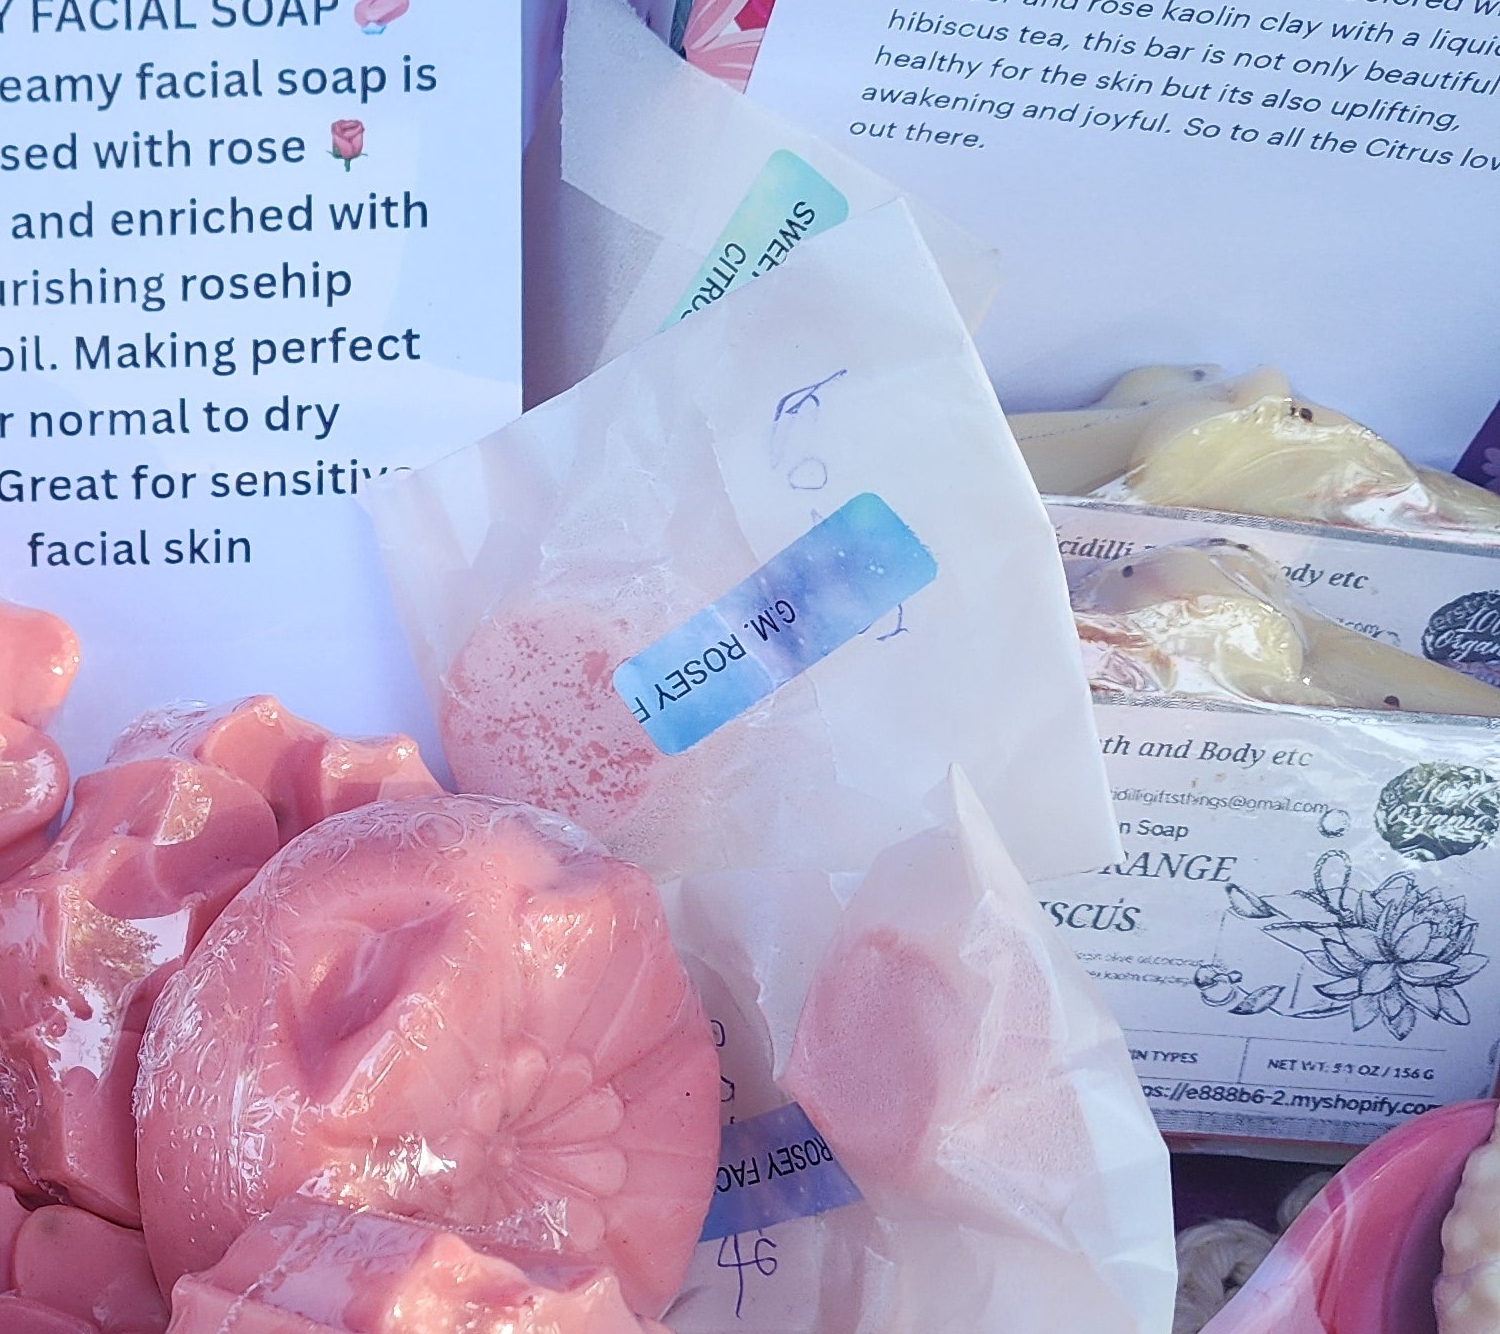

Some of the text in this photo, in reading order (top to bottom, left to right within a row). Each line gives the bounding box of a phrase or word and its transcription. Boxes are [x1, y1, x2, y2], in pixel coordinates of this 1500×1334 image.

[1259, 11, 1324, 40] clay
[1331, 20, 1394, 45] with
[1401, 31, 1421, 47] a
[887, 8, 1500, 95] hibiscus tea, this bar is not only beautiful
[135, 58, 263, 101] facial
[277, 65, 387, 105] soap
[402, 54, 437, 93] is
[874, 44, 1460, 132] healthy for the skin but its also uplifting,
[849, 121, 985, 149] out there.
[860, 86, 1016, 120] awakening
[1021, 102, 1081, 123] and
[1078, 105, 1172, 134] joyful.
[1183, 117, 1222, 139] So
[1229, 123, 1260, 143] to
[1266, 126, 1306, 148] all
[1309, 131, 1358, 154] the
[1365, 137, 1454, 165] Citrus
[92, 128, 191, 170] with
[208, 136, 306, 167] rose
[11, 200, 94, 240] and
[110, 193, 313, 237] enriched
[328, 190, 428, 231] with
[751, 200, 816, 278] SWEE
[181, 260, 352, 308] rosehip
[74, 331, 237, 377] Making
[251, 326, 421, 376] perfect
[29, 397, 191, 438] normal
[202, 401, 249, 434] to
[264, 394, 341, 441] dry
[130, 464, 197, 501] for
[210, 459, 411, 498] sensiti
[26, 528, 251, 568] facial skin
[1328, 571, 1370, 591] etc
[654, 632, 747, 712] ROSEY
[1100, 735, 1315, 770] th and Body etc
[1136, 819, 1190, 842] Soap
[1039, 900, 1142, 932] SCUS
[1150, 1050, 1199, 1064] TYPES
[1267, 1058, 1298, 1071] NET
[1358, 1064, 1381, 1077] OZ
[1393, 1067, 1421, 1079] 156
[1423, 1069, 1435, 1081] G
[767, 1134, 835, 1180] ROSEY
